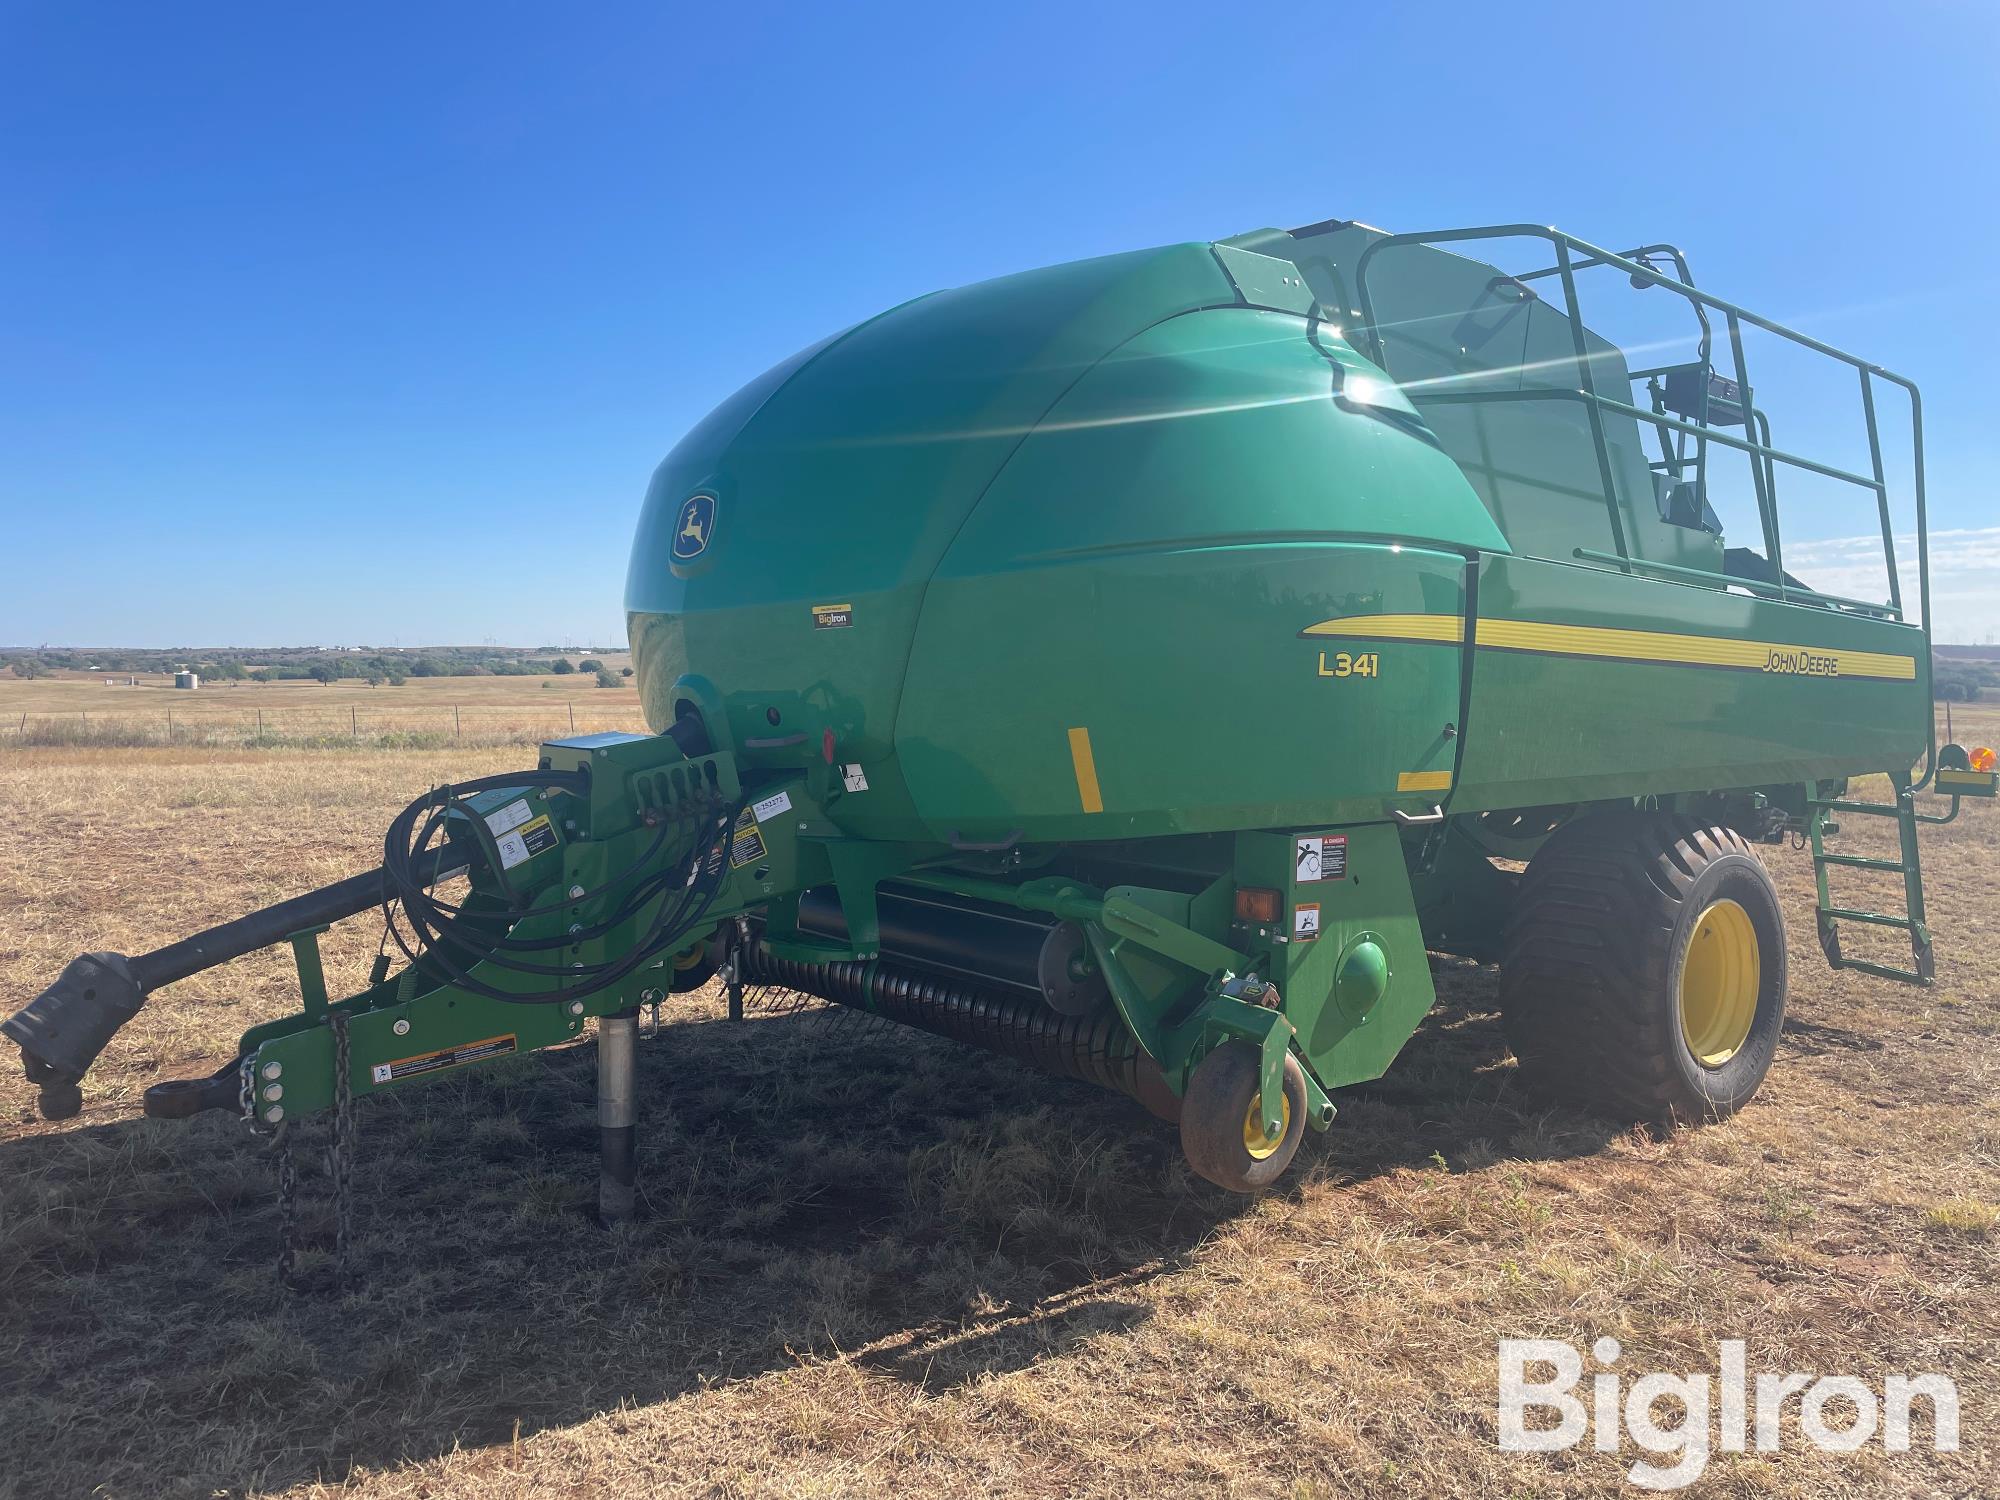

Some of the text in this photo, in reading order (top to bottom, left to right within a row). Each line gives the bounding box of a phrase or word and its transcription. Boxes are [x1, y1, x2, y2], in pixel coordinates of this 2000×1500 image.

[818, 613, 847, 625] BigIron
[1317, 651, 1379, 678] L341
[1763, 648, 1839, 675] JOHN DEERE
